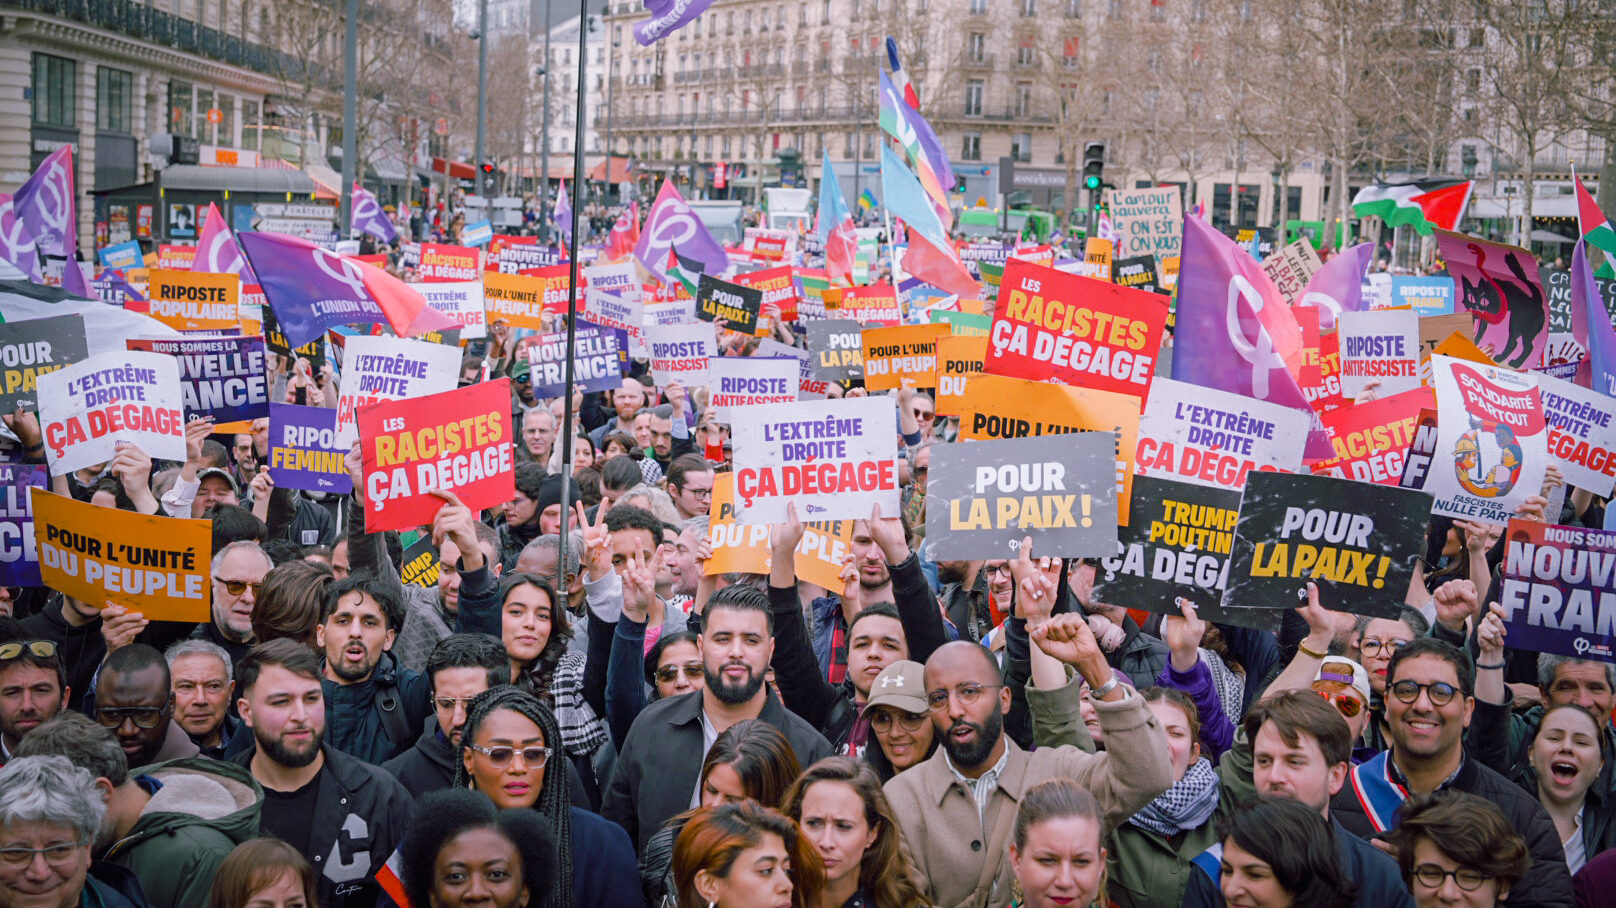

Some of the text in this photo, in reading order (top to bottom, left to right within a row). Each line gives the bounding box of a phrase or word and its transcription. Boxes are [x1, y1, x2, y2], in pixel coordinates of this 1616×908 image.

[423, 253, 474, 268] RACISTES
[500, 248, 558, 265] NOUVELLE
[420, 264, 477, 280] ÇA DÉGAGE
[593, 274, 628, 287] RIPOSTE
[160, 284, 227, 301] RIPOSTE
[485, 287, 538, 302] POUR L'UNITÉ
[1020, 277, 1042, 292] LES
[1400, 286, 1449, 298] RIPOSTE
[150, 300, 237, 320] POPULAIRE
[495, 298, 540, 318] PEUPLE
[702, 298, 717, 314] LA
[711, 289, 745, 309] POUR
[843, 297, 895, 309] RACISTES
[856, 305, 899, 321] DÉGAGE
[1005, 289, 1149, 351] RACISTES
[152, 340, 238, 353] NOUS SOMMES LA
[652, 341, 706, 358] RIPOSTE
[829, 333, 862, 349] POU
[869, 343, 937, 358] POUR L'UNIT
[991, 320, 1153, 386] ÇA DÉGAGE
[1346, 336, 1405, 357] RIPOSTE
[355, 354, 428, 380] L'EXTRÊME
[652, 357, 710, 372] ANTIFASCIST
[820, 352, 838, 368] LA
[867, 355, 936, 376] DU PEUP
[946, 360, 984, 374] POUR
[1343, 359, 1417, 376] ANTIFASCISTE
[67, 363, 157, 396] L'EXTRÊME
[359, 373, 408, 397] DROITE
[720, 377, 788, 393] RIPOSTE
[939, 375, 965, 396] DU
[1460, 373, 1536, 409] SOLIDARITÉ
[85, 385, 147, 409] DROITE
[181, 376, 266, 410] ANCE
[1467, 390, 1529, 426] PARTOUT
[46, 397, 184, 459] ÇA DÉGAGE
[383, 417, 405, 432] LES
[764, 414, 863, 441] L'EXTRÊME
[973, 412, 1030, 439] POUR
[1174, 402, 1275, 440] L'EXTRÊME
[283, 424, 334, 448] RIPO
[375, 411, 503, 467] RACISTES
[1188, 426, 1254, 456] DROITE
[1331, 415, 1418, 464] ACISTE
[782, 440, 846, 461] DROITE
[1135, 436, 1175, 476] ÇA
[1547, 424, 1616, 477] ÉGAGE
[367, 441, 512, 512] ÇA DÉGAGE
[737, 455, 895, 508] ÇA DÉGAGE
[975, 462, 1066, 493] POUR
[950, 497, 992, 531] LA
[1434, 498, 1516, 525] NULLE PART
[1453, 494, 1504, 511] FASCISTES
[1163, 499, 1239, 532] TRUMP
[1280, 506, 1374, 549] POUR
[46, 523, 102, 558] POUR
[107, 541, 196, 571] L'UNITÉ
[712, 523, 744, 550] DU
[1150, 520, 1234, 555] POUTIN
[1544, 527, 1616, 550] NOUS SOM
[41, 541, 204, 600] DU PEUPLE
[1101, 540, 1145, 582] ÇA
[1249, 541, 1280, 578] LA
[1505, 540, 1616, 588] NOUV
[1501, 578, 1616, 638] FRAN
